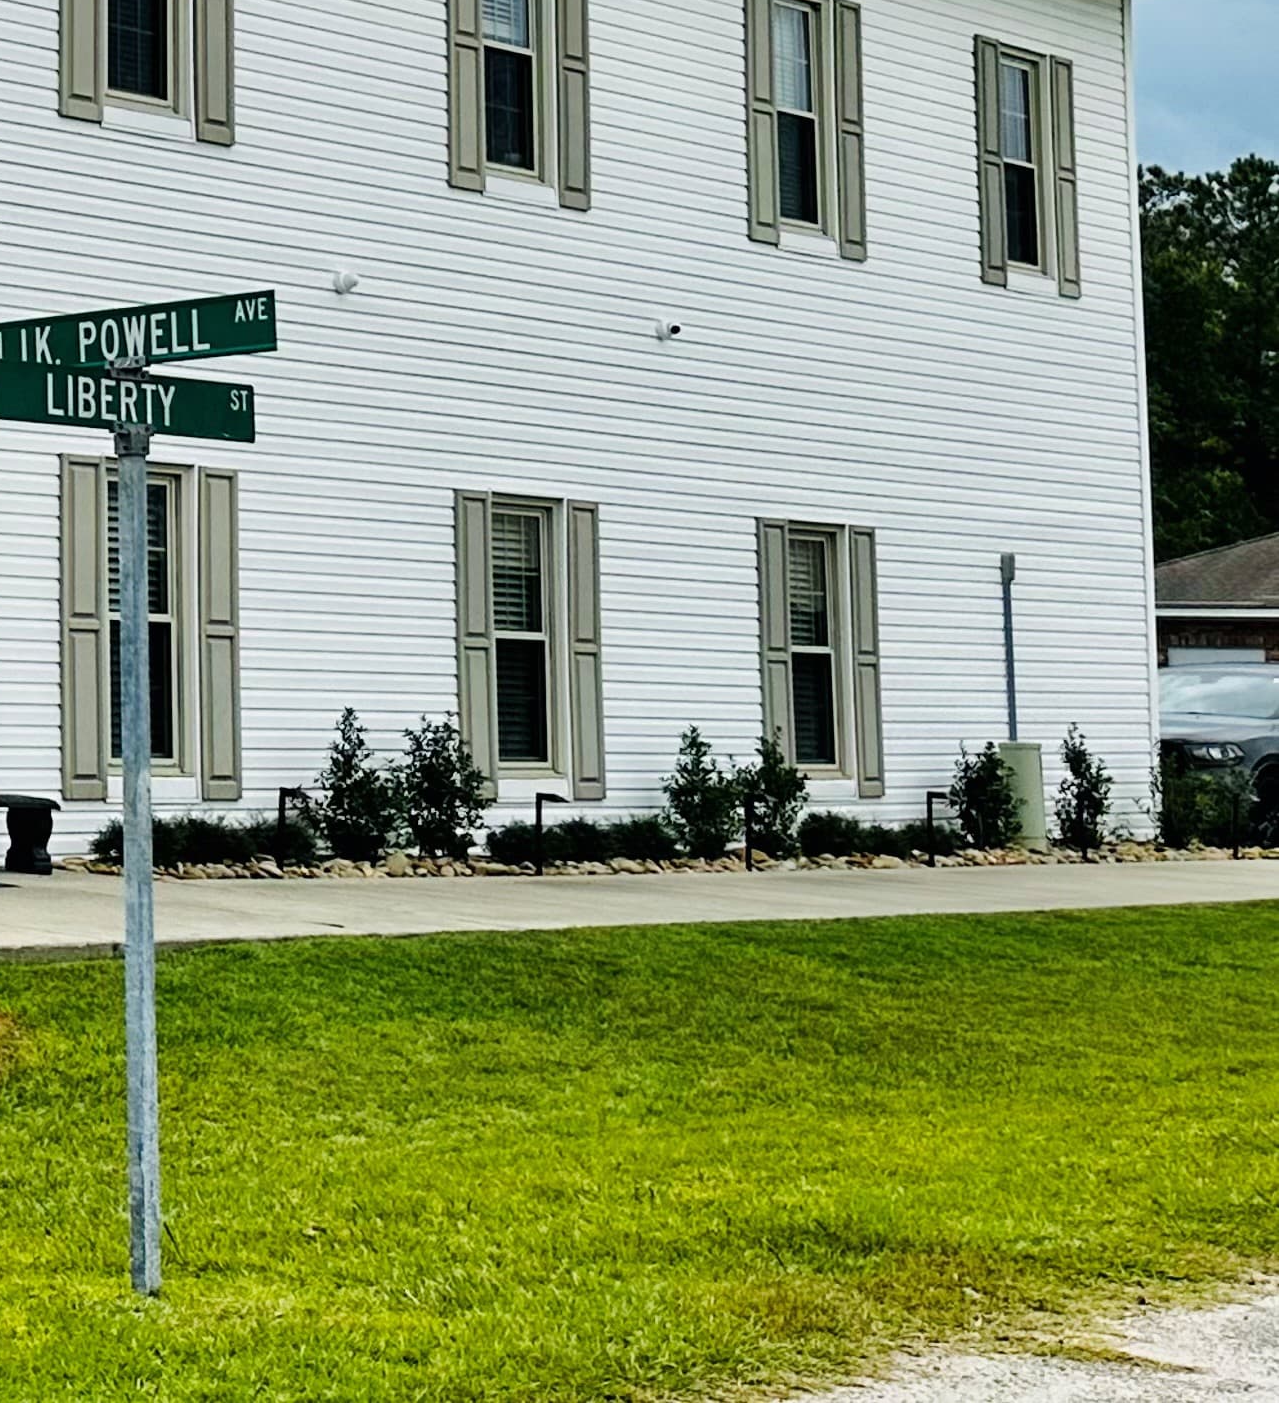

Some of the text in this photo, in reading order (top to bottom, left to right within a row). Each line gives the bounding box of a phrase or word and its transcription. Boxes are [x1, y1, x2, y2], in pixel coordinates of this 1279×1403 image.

[78, 308, 211, 363] POWELL
[234, 297, 269, 323] AVE
[46, 372, 248, 427] LIBERTY ST
